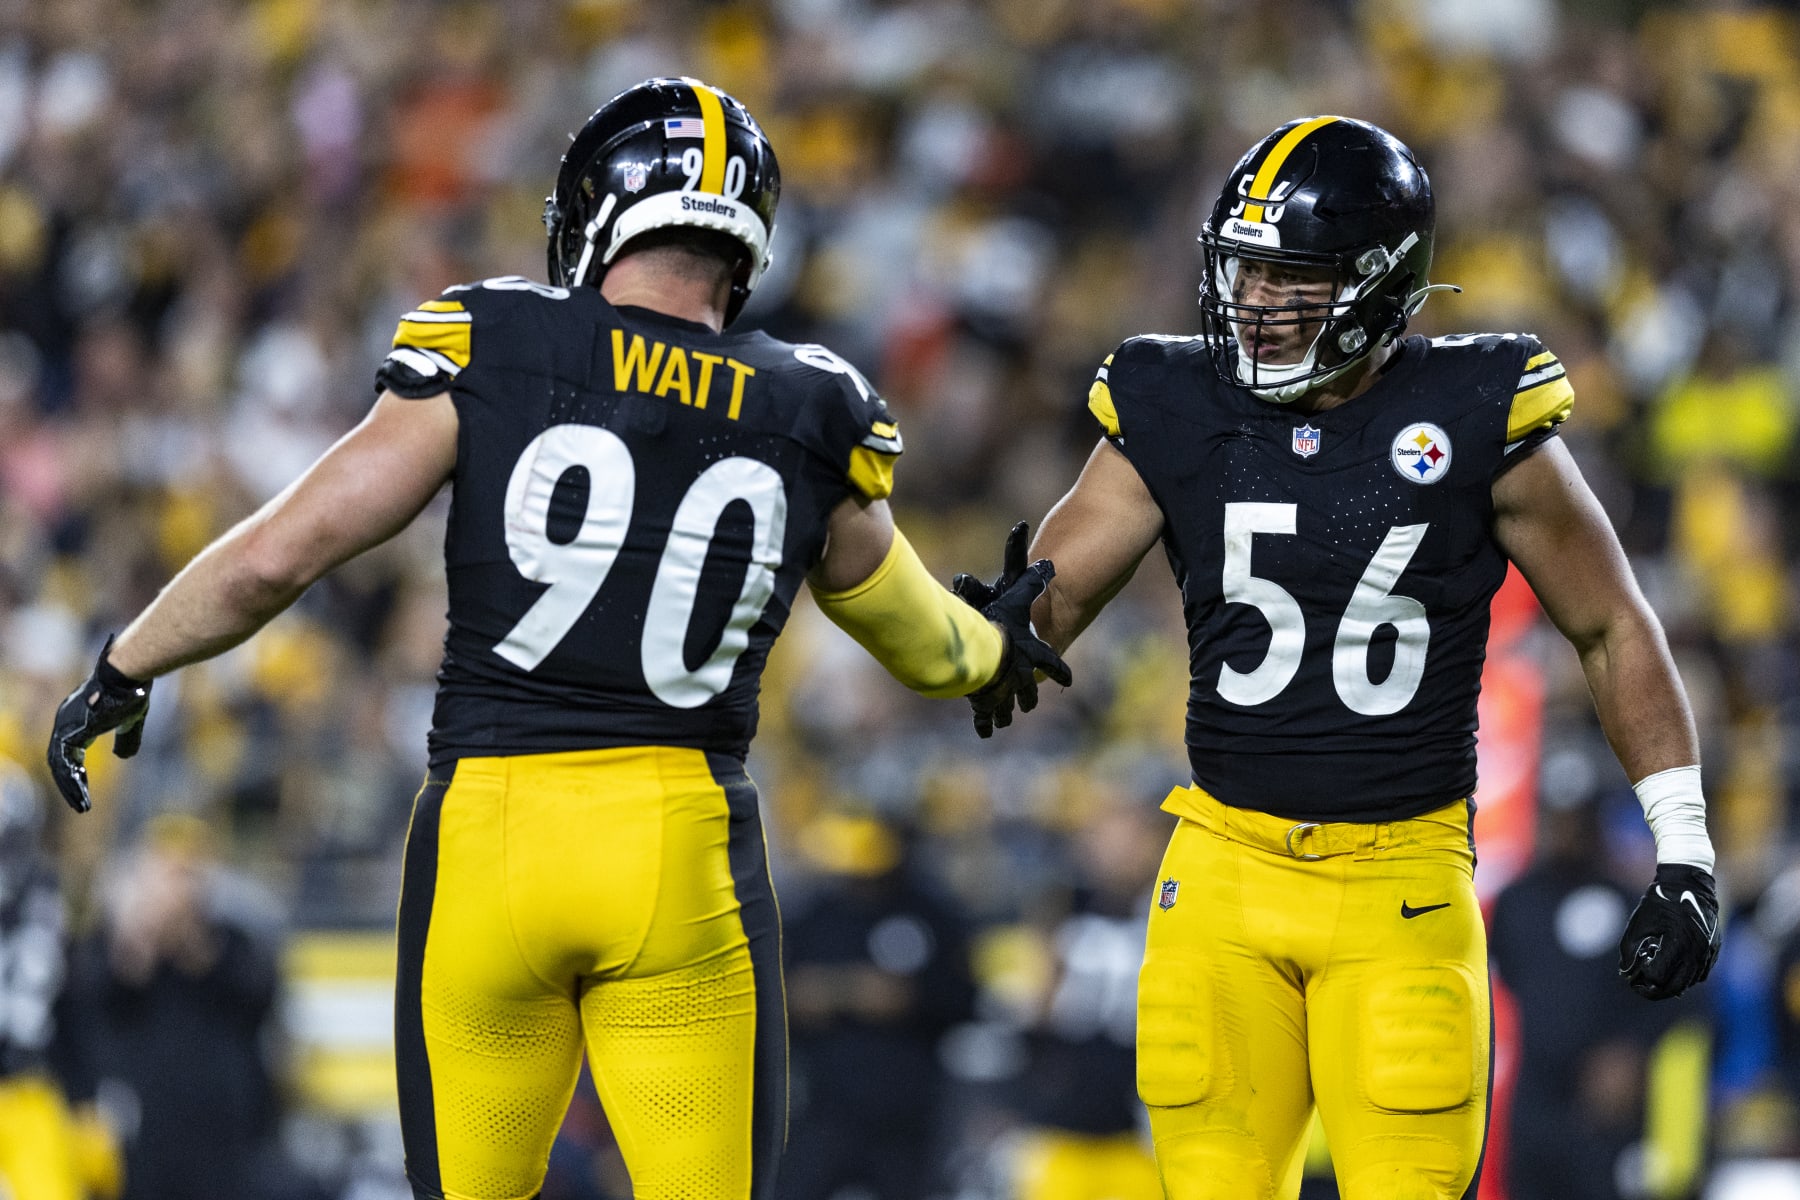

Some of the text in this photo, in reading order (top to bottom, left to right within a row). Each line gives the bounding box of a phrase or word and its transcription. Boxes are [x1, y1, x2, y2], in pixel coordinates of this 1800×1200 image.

[682, 147, 746, 200] 90
[1229, 173, 1291, 223] 56
[681, 195, 737, 219] Steelers
[1232, 221, 1263, 238] Steelers
[610, 329, 755, 420] WATT
[1297, 438, 1316, 451] NFL
[1397, 447, 1422, 456] Steelers
[492, 423, 788, 709] 90
[1216, 502, 1431, 716] 56
